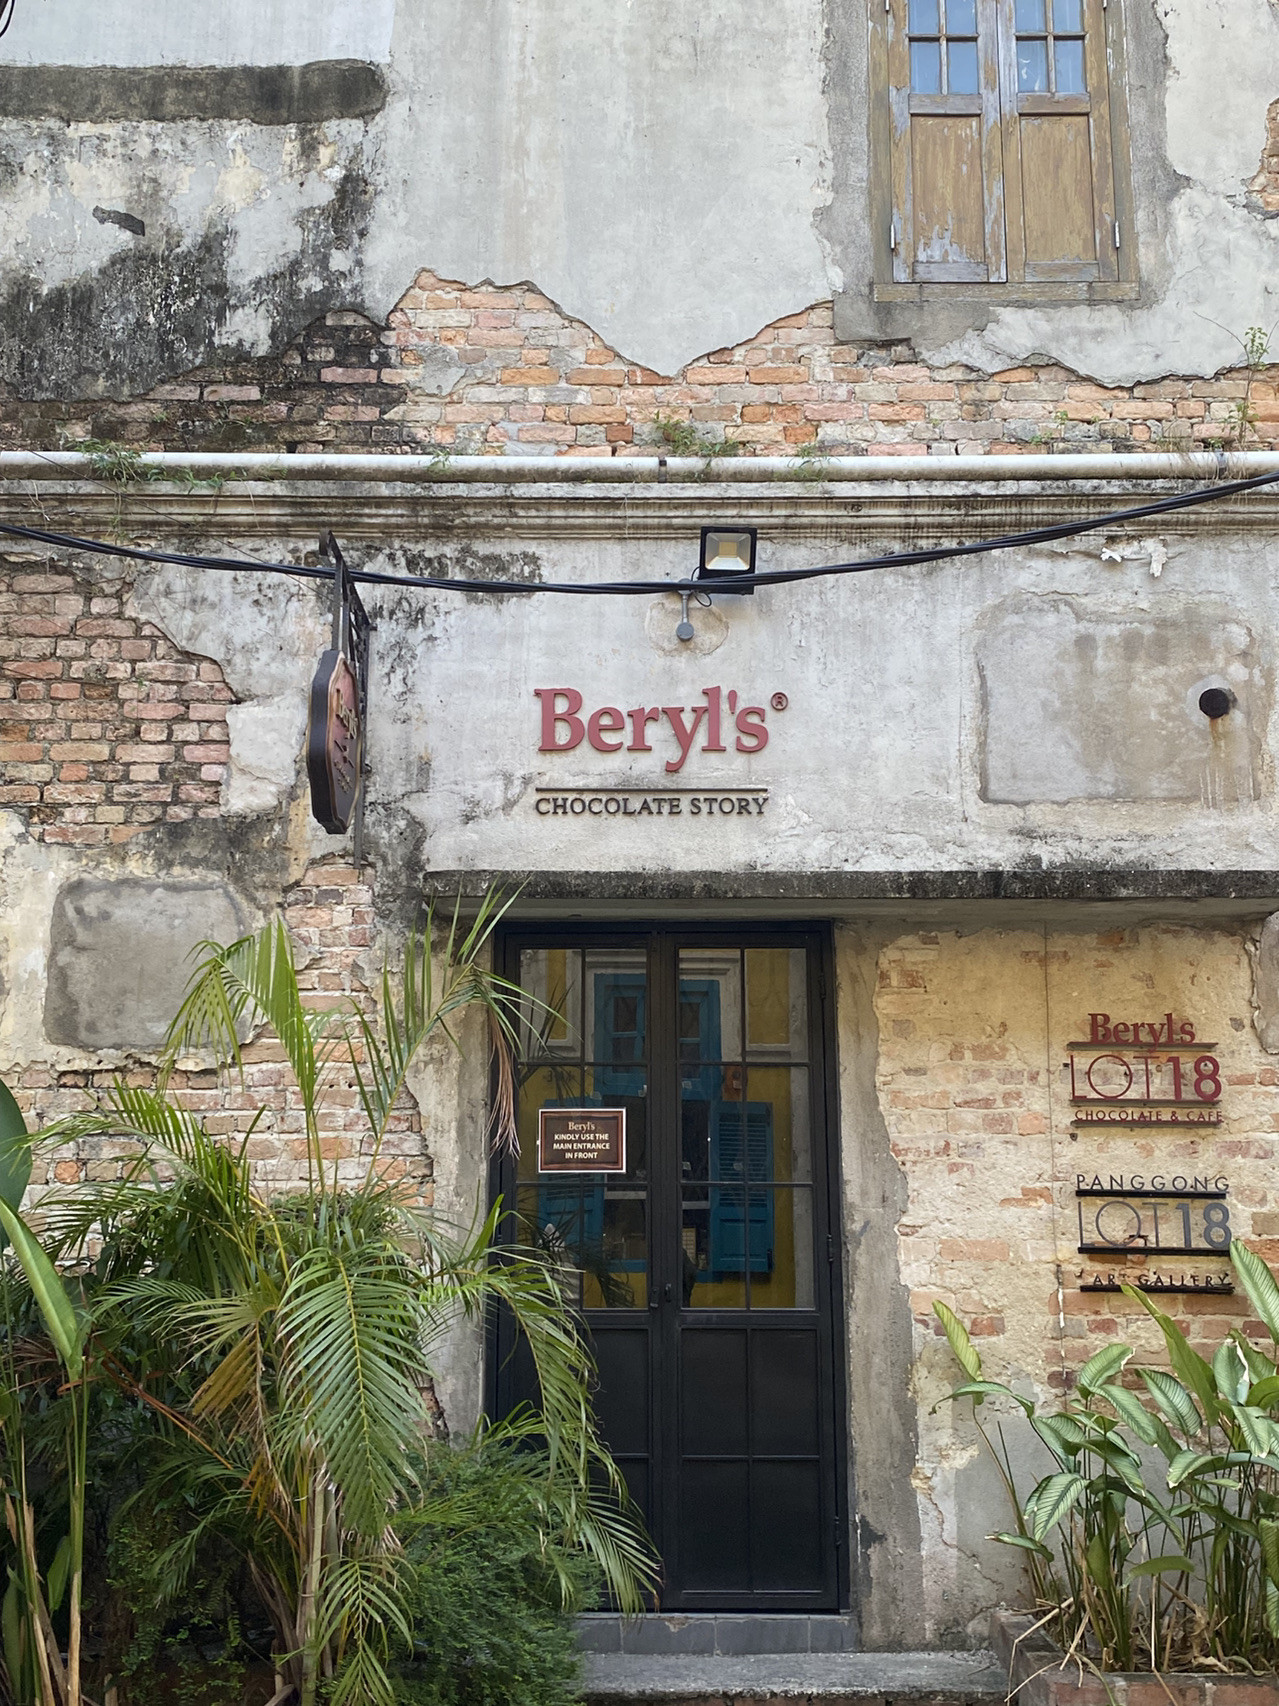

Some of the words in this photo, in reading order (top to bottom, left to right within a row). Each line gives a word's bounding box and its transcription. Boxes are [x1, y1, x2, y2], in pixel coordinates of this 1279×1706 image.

[534, 796, 683, 816] CHOCOLATE
[690, 796, 769, 816] STORY
[1075, 1109, 1163, 1122] CHOCOLATE
[1170, 1109, 1180, 1122] &
[1186, 1109, 1224, 1123] CAFE
[568, 1122, 595, 1132] Beryl's
[1076, 1174, 1230, 1192] PANGGONG
[1138, 1274, 1230, 1287] GALLERY
